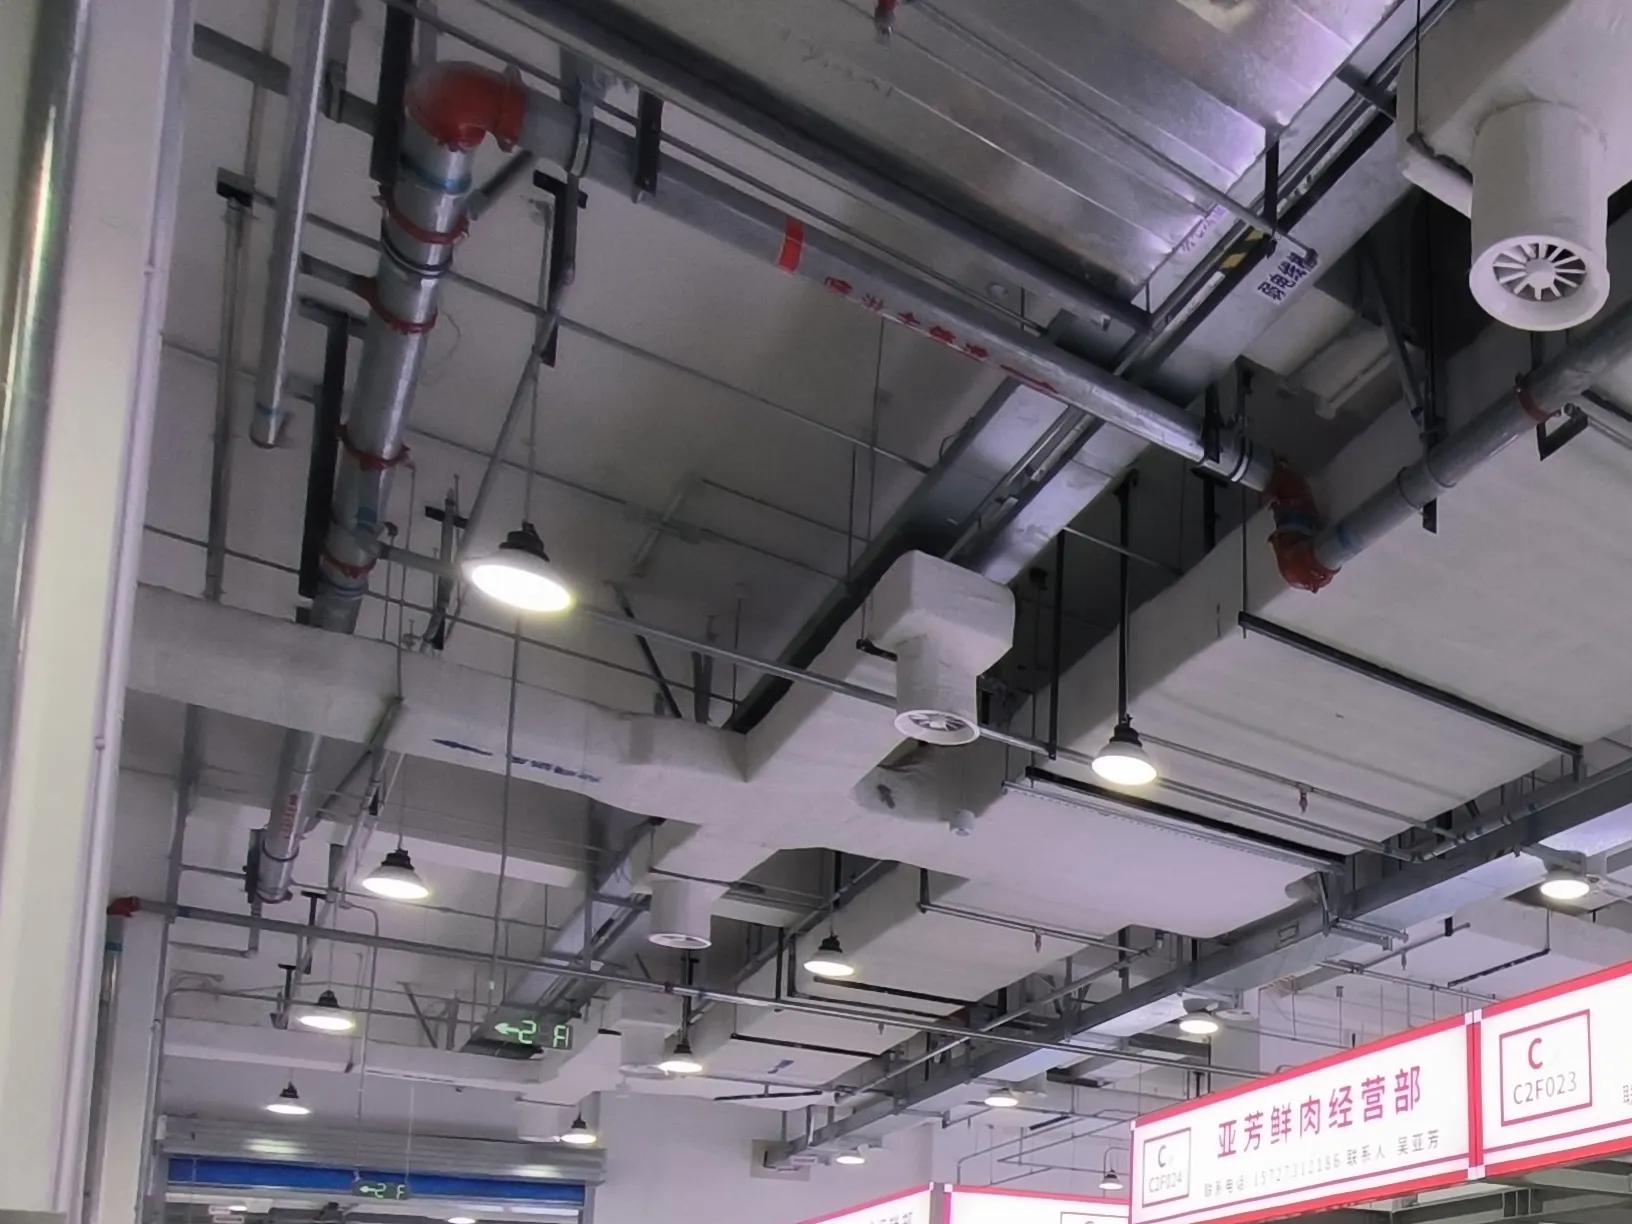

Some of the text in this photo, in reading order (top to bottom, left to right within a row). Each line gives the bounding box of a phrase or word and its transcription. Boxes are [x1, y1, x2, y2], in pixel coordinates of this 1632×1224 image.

[1528, 1037, 1543, 1070] C
[1513, 1071, 1577, 1104] C2F023
[1217, 1065, 1420, 1158] 亚芳鲜肉经营部
